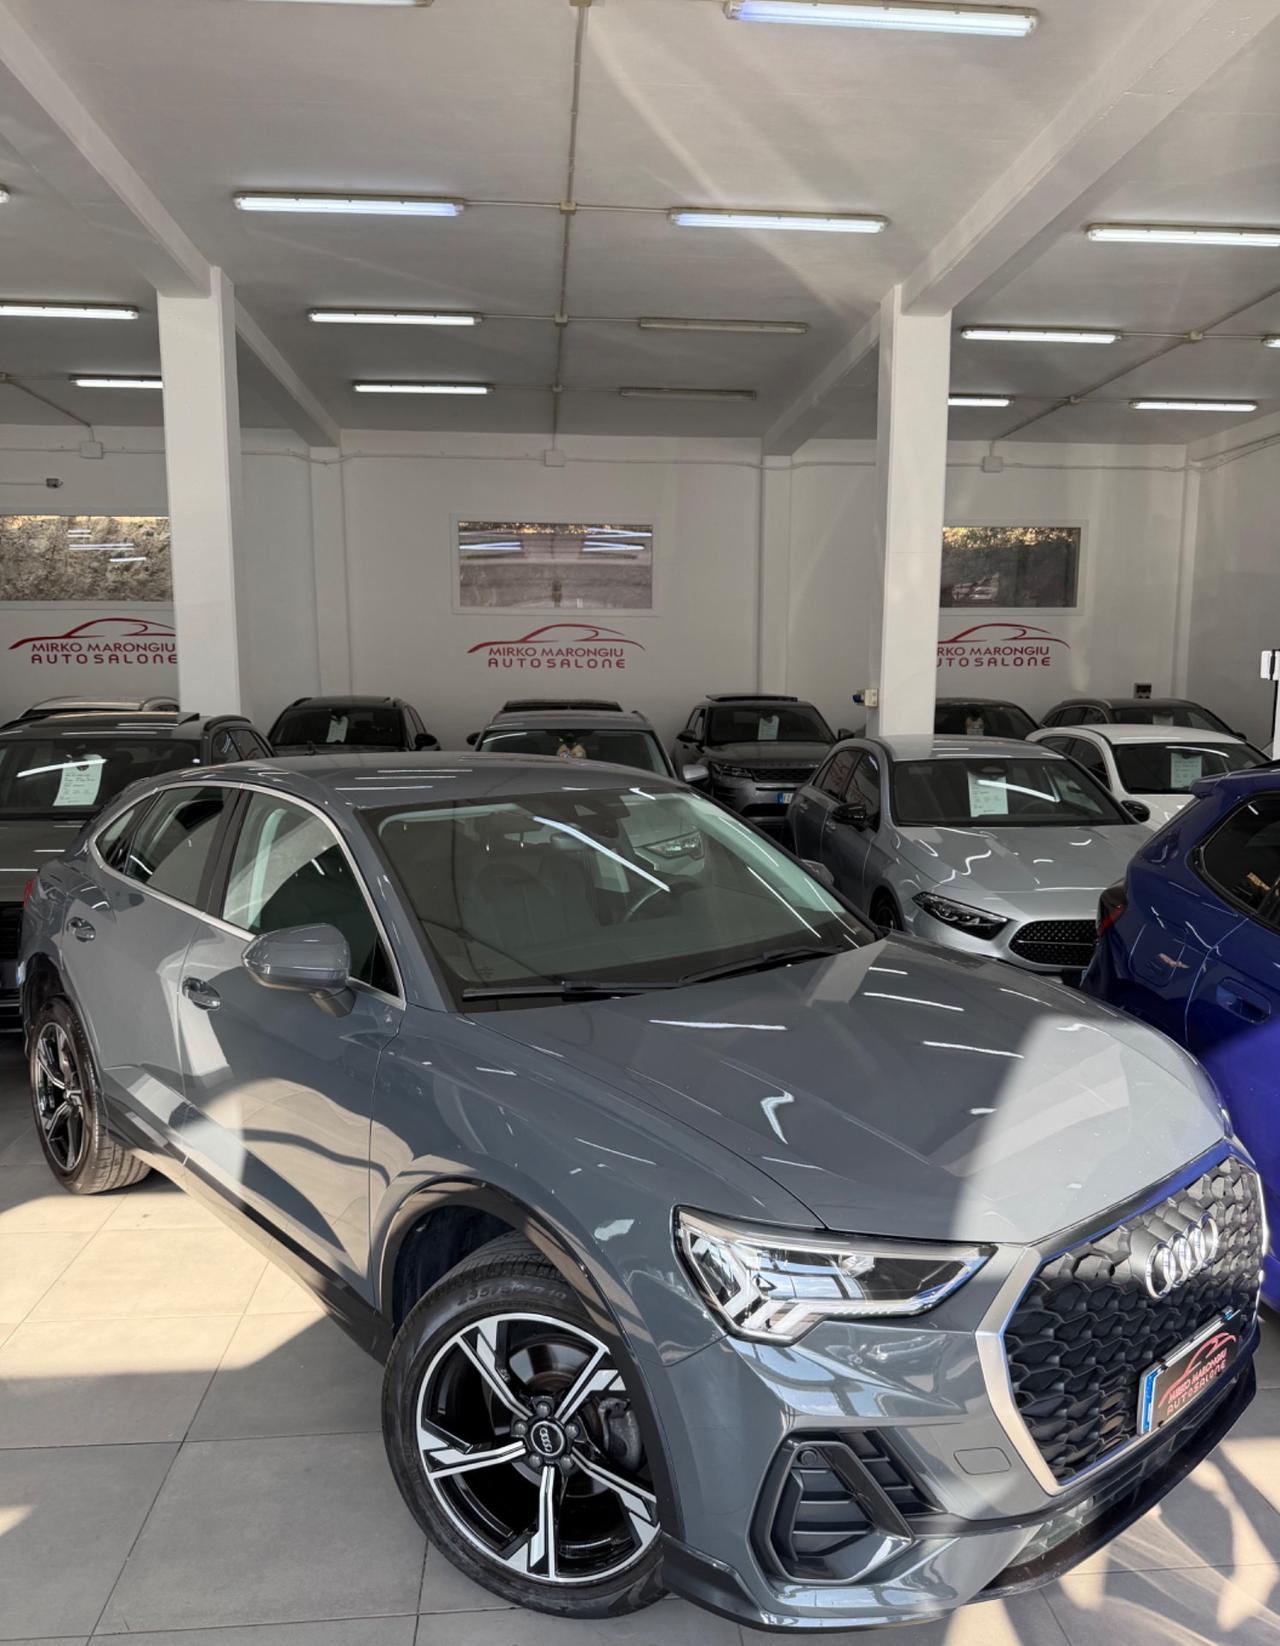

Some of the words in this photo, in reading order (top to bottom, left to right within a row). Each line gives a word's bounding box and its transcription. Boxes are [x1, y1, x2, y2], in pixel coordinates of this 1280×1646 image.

[32, 643, 83, 653] MIRKO
[87, 642, 176, 653] MARONGIU
[489, 647, 537, 657] MIRKO
[541, 647, 624, 657] MARONGIU
[937, 646, 966, 656] RKO
[969, 646, 1050, 656] MARONGIU
[31, 653, 179, 665] AUTOSALONE
[488, 657, 626, 669] AUTOSALONE
